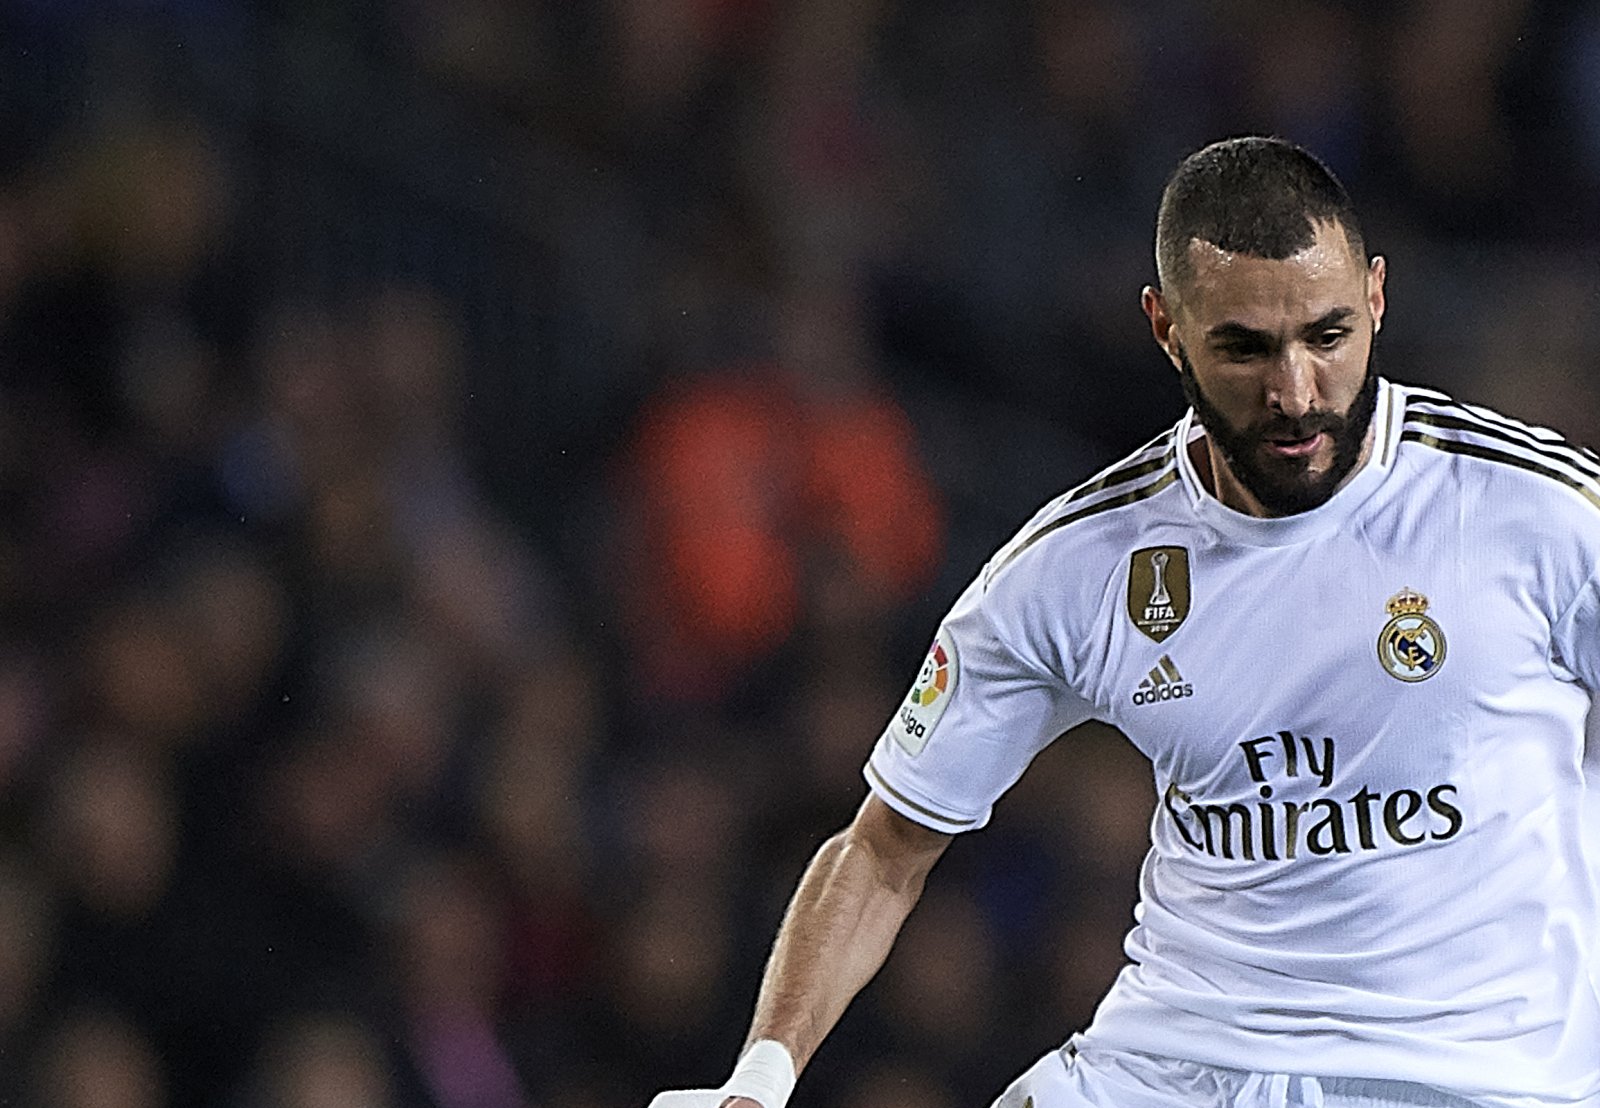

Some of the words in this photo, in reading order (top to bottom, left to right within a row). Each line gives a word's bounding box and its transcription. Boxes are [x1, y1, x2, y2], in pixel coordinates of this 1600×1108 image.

[1144, 605, 1175, 620] FIFA
[1132, 682, 1194, 706] adidas
[1239, 730, 1335, 788] Fly
